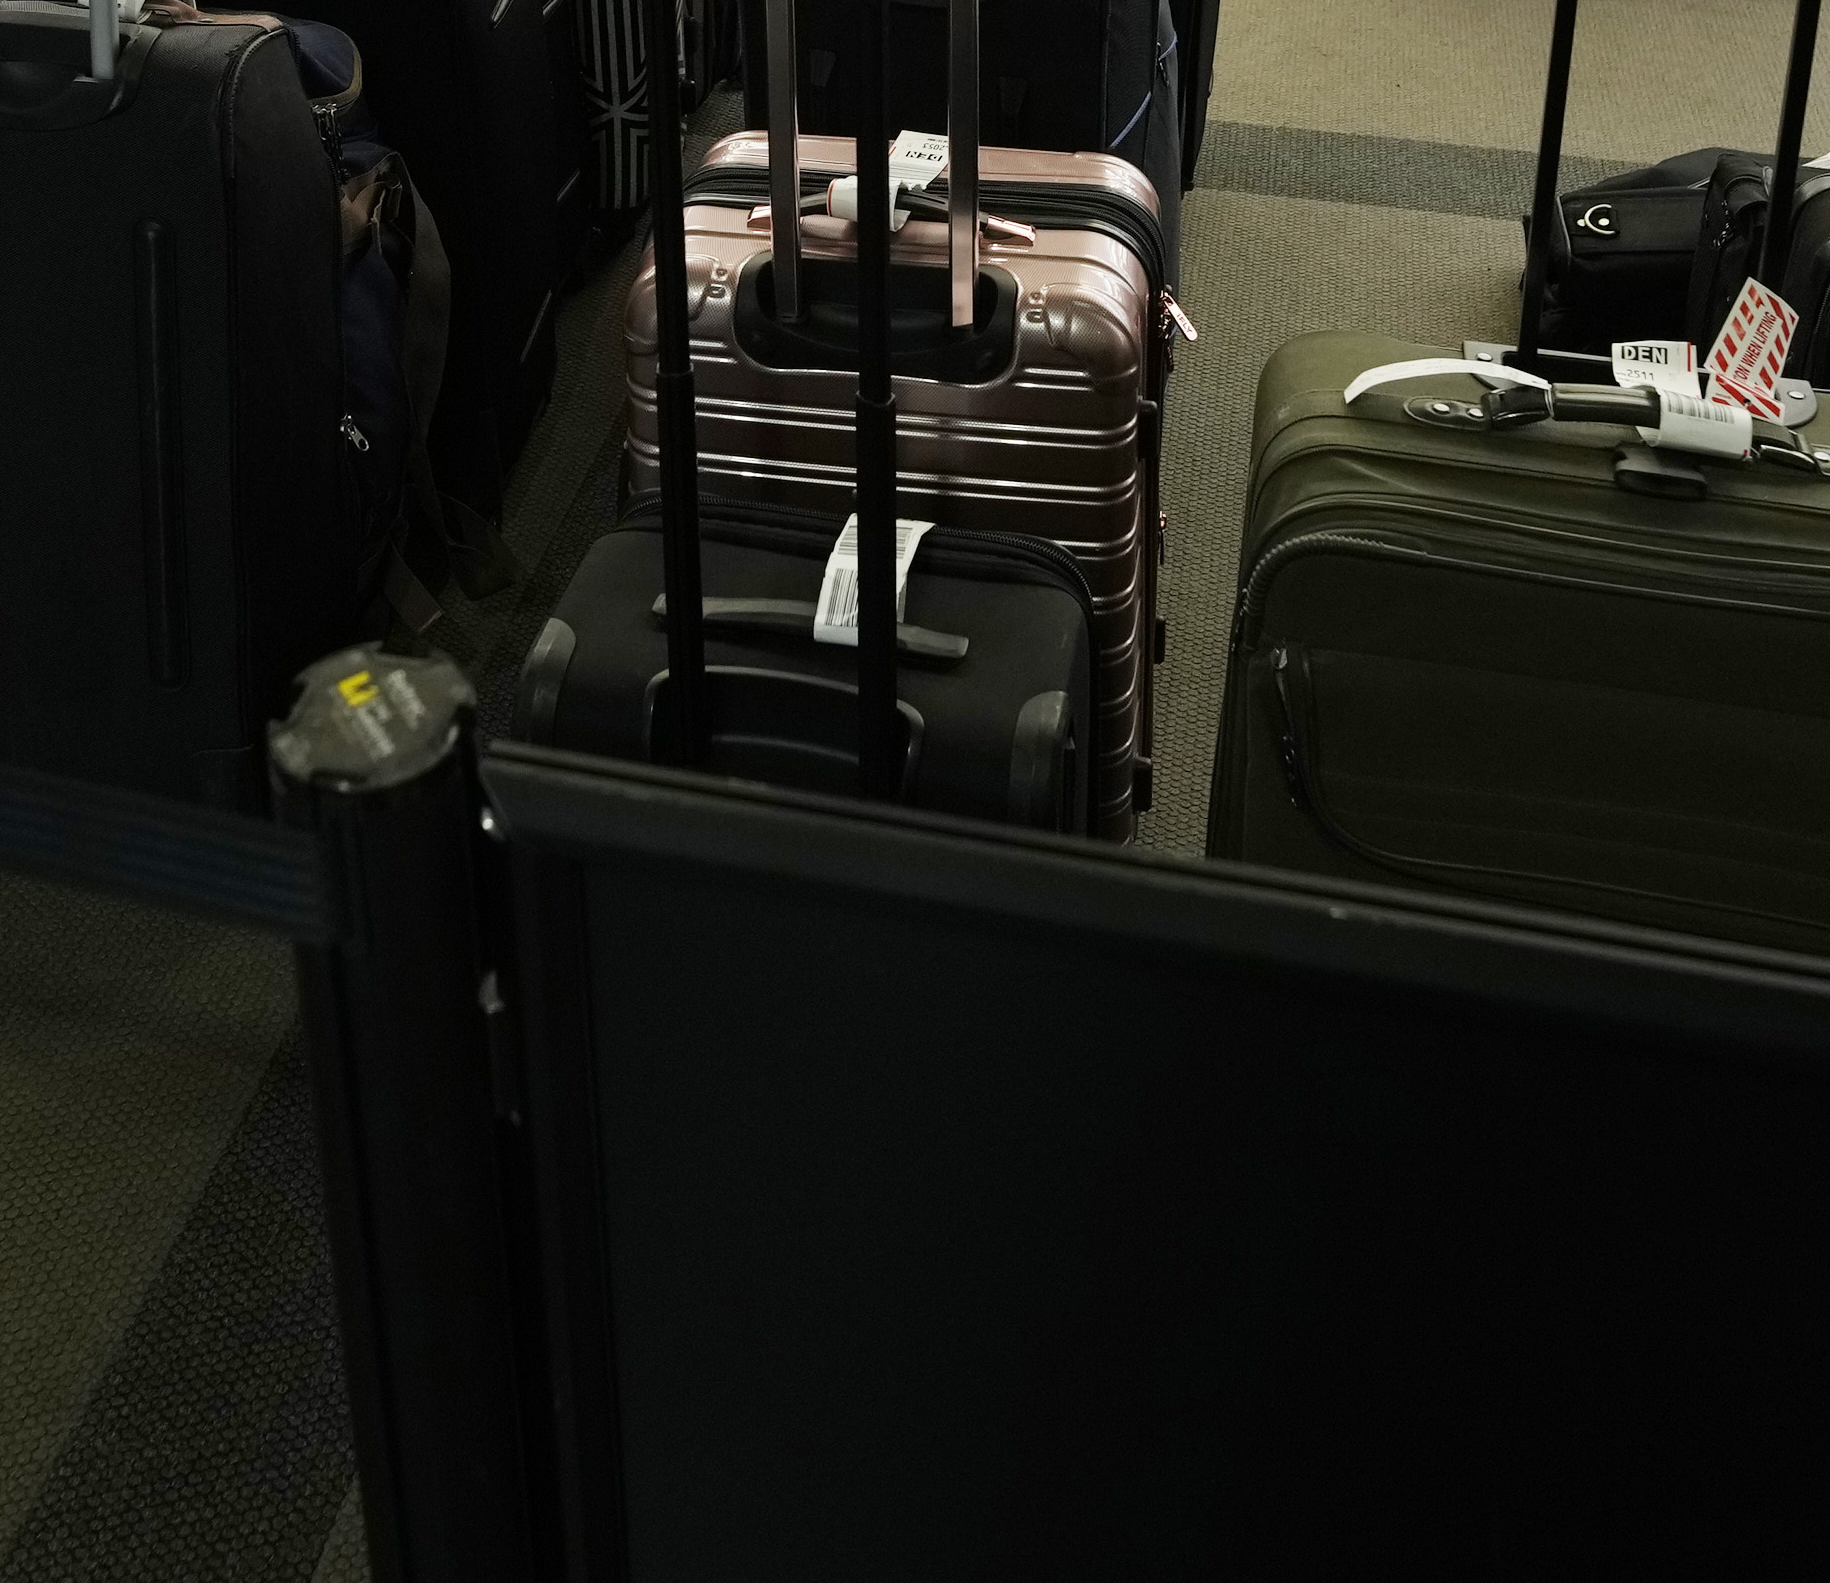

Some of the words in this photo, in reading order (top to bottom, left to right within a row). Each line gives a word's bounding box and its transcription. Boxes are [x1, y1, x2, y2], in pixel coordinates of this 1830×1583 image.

[906, 150, 943, 162] DEN
[1740, 343, 1764, 372] WHEN
[1753, 311, 1778, 347] LIFTING
[1622, 345, 1668, 365] DEN
[1626, 368, 1655, 382] 2511
